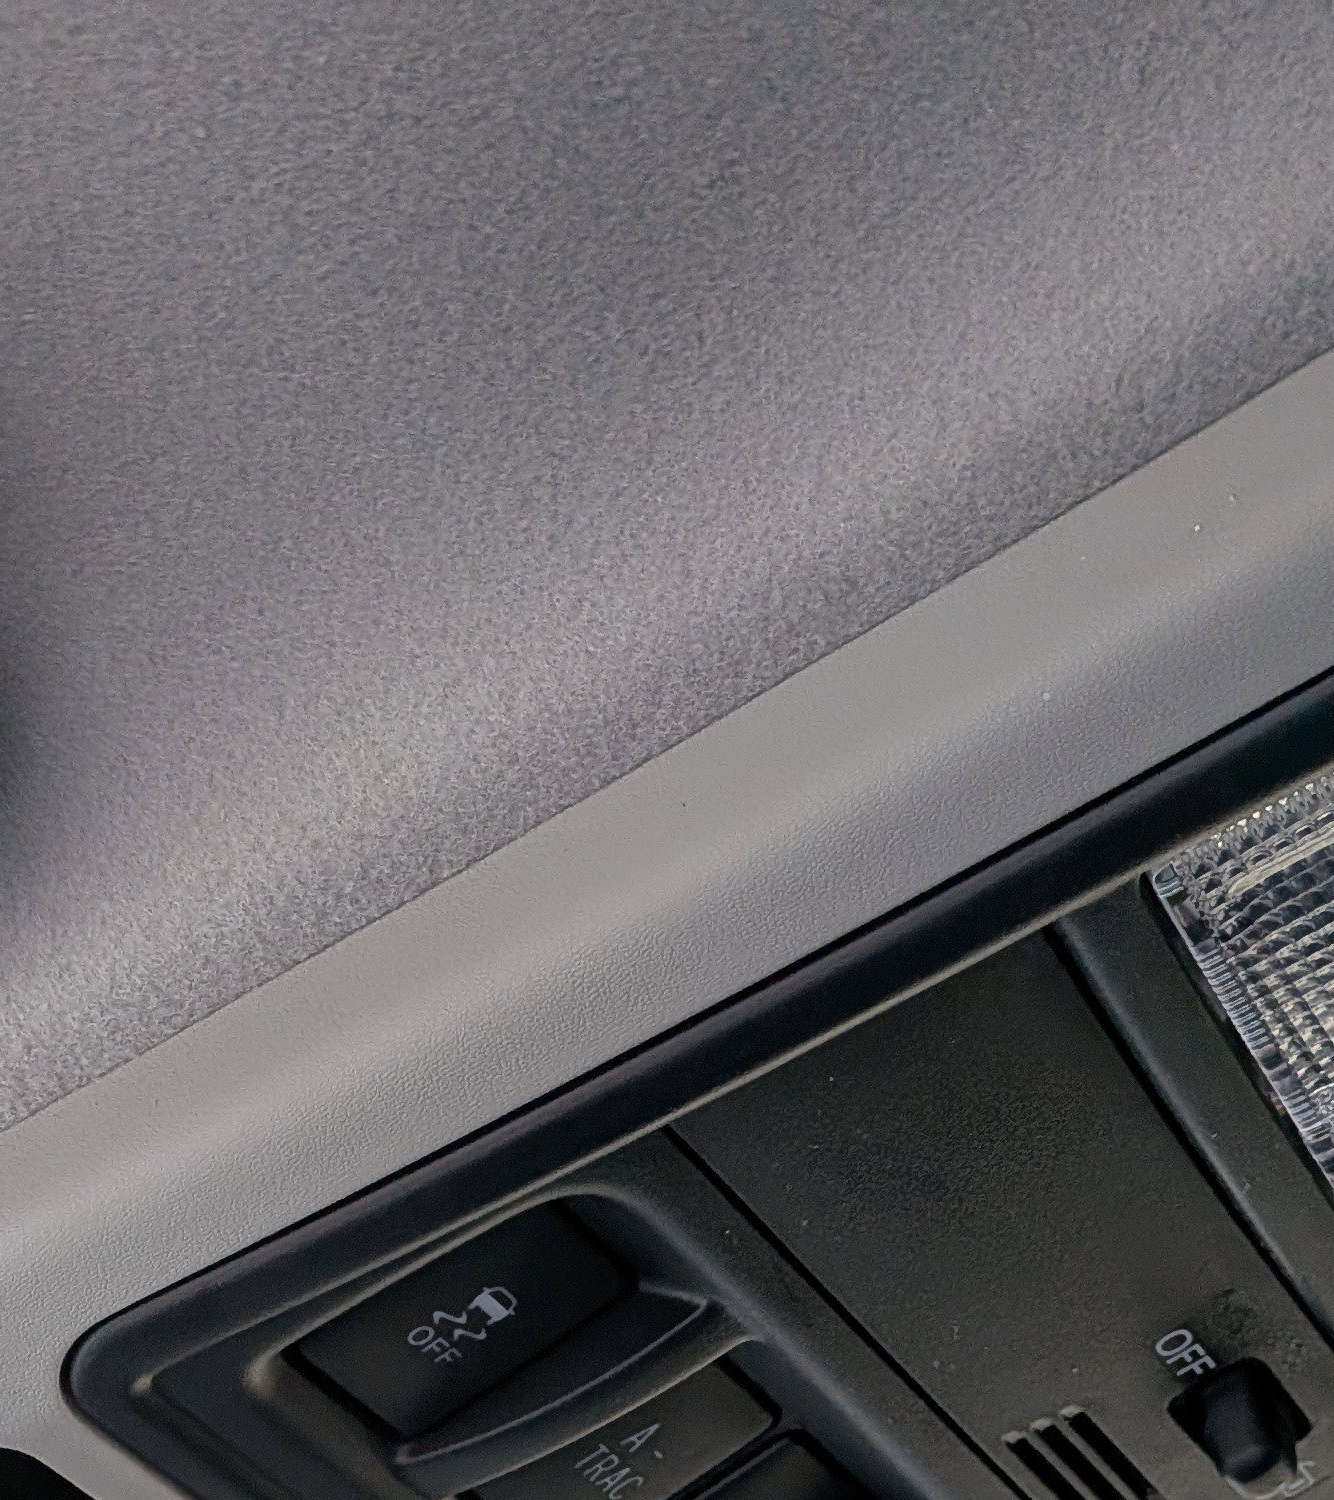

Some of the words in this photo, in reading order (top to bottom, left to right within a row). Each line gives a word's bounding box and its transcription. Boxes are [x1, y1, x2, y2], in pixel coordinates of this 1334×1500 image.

[407, 1325, 463, 1363] OFF
[1155, 1328, 1218, 1377] OFF
[574, 1443, 645, 1500] TRAC
